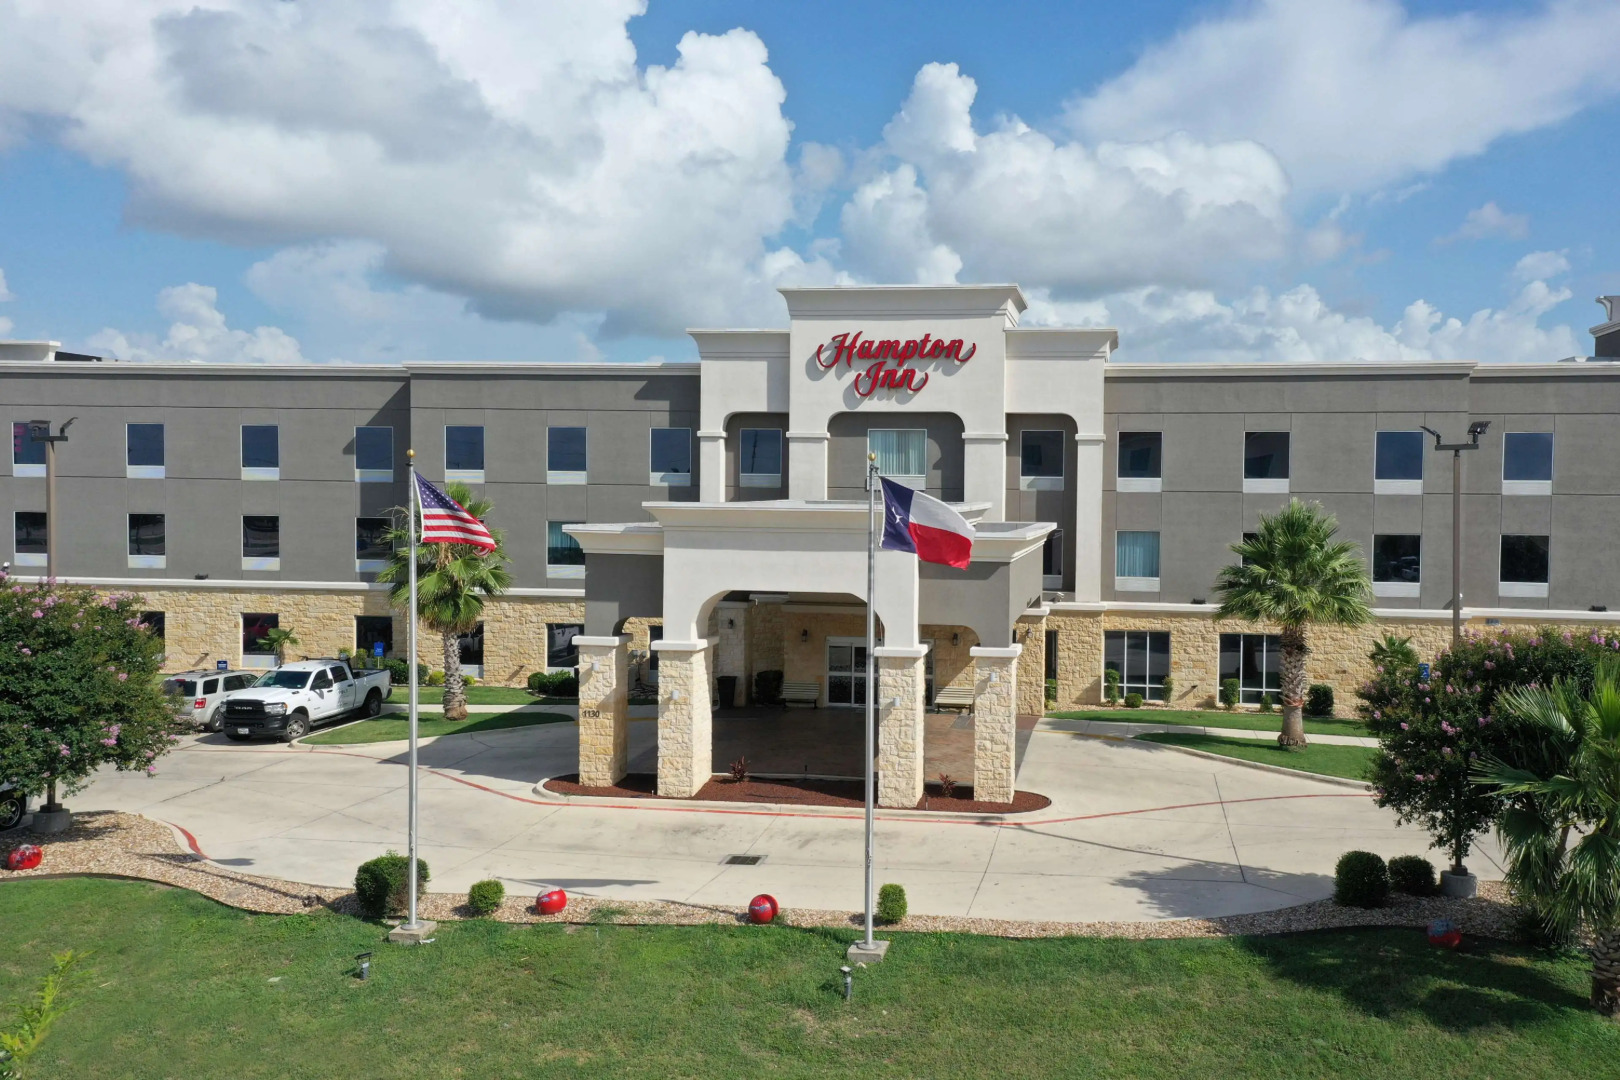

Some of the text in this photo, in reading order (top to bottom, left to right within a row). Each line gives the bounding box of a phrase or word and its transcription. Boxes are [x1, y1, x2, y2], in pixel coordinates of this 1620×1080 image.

[816, 331, 977, 368] Hampton
[854, 361, 929, 397] Inn
[582, 710, 600, 718] 1130
